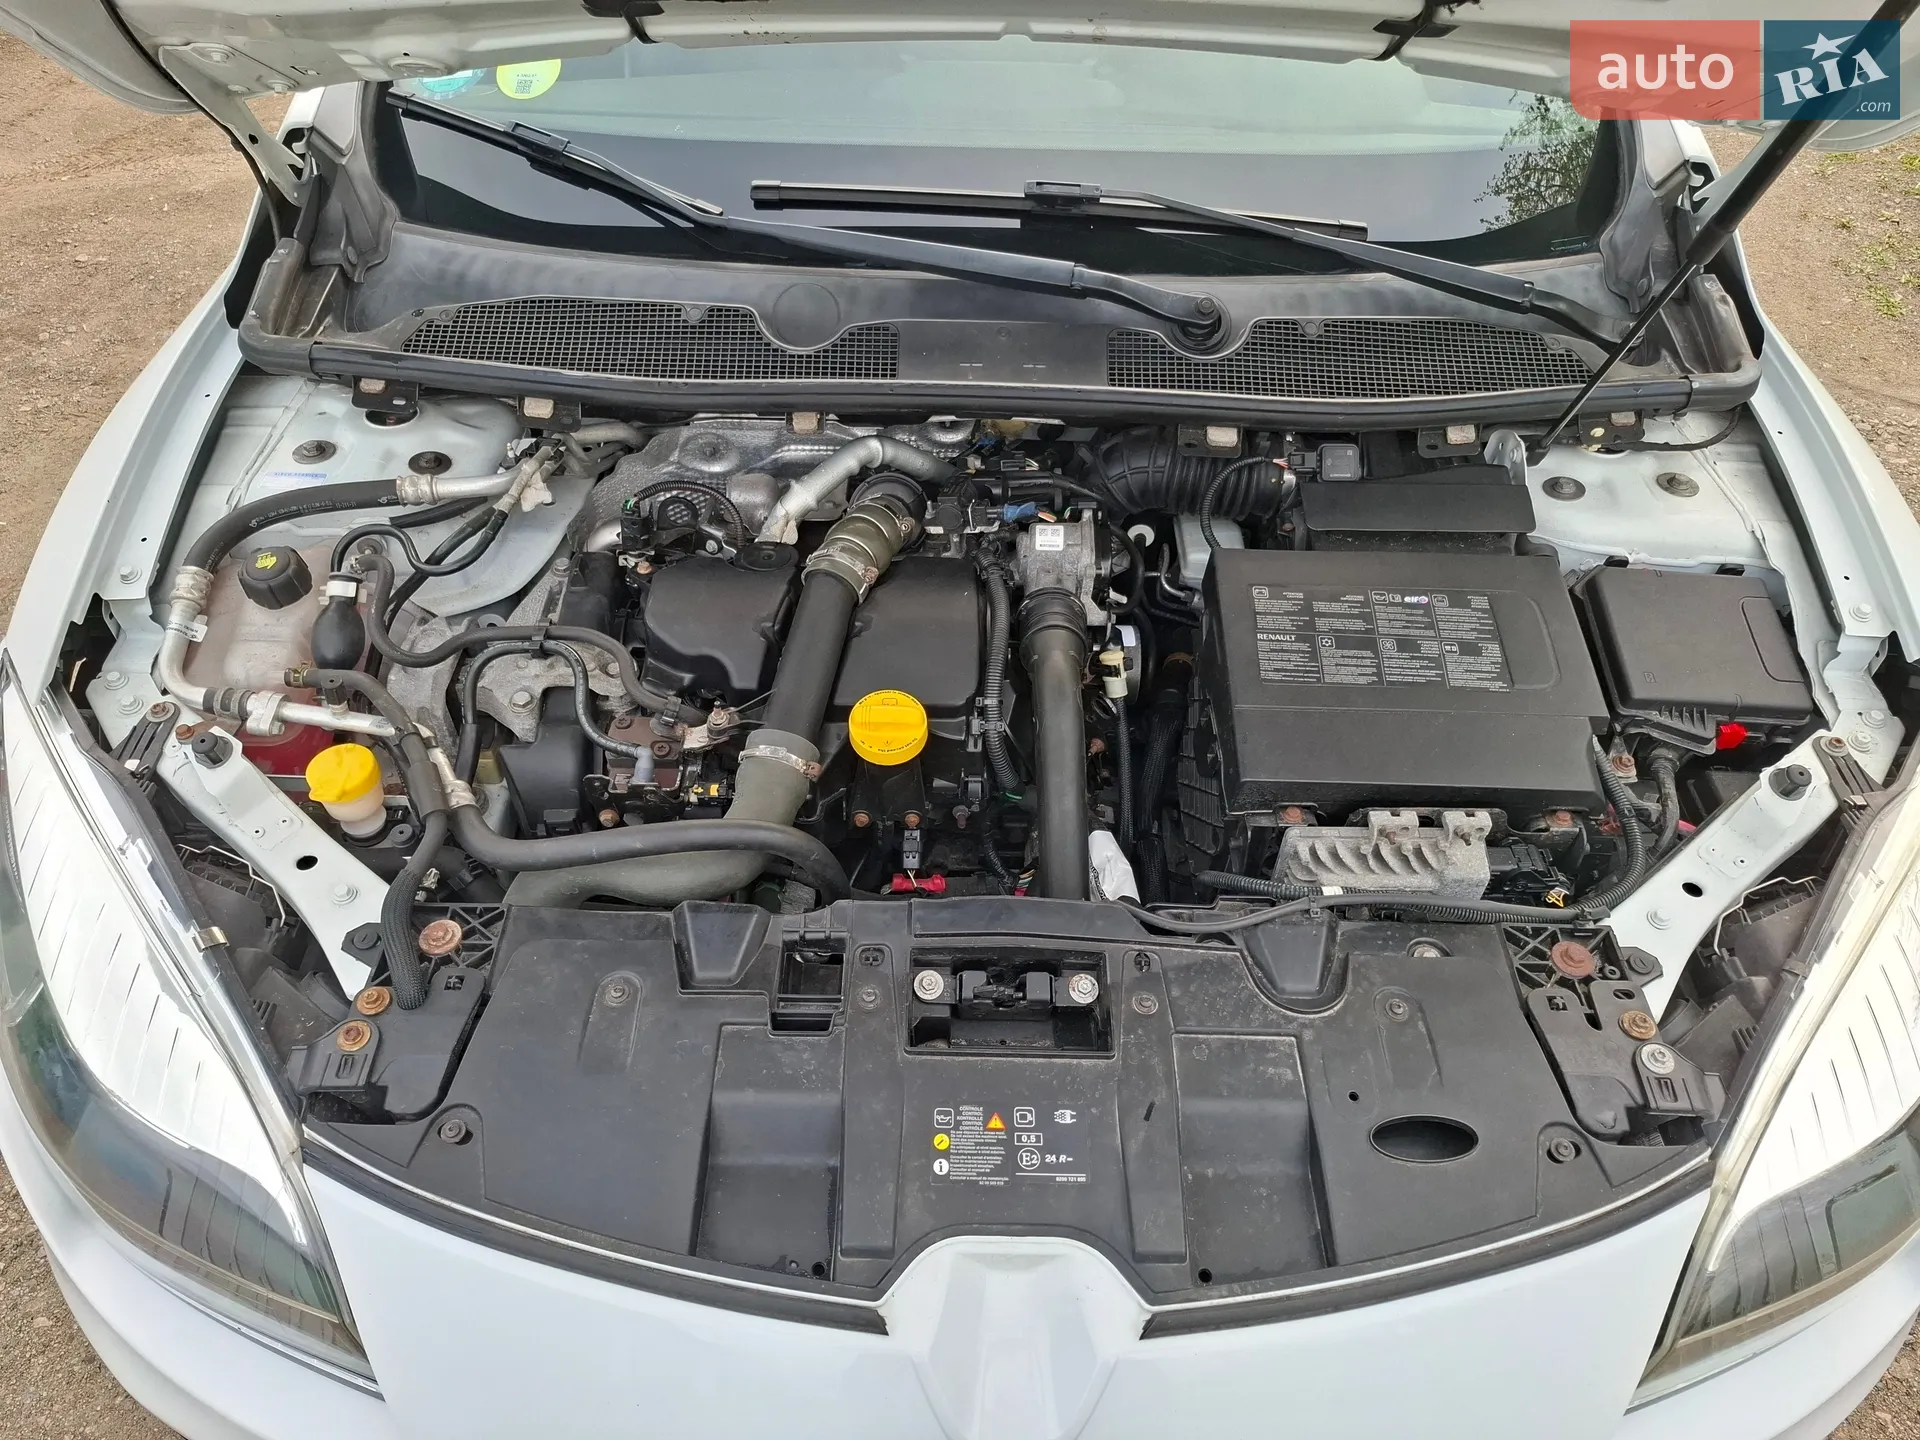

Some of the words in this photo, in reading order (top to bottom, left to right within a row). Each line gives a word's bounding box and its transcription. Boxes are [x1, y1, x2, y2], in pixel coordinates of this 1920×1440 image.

[1022, 1135, 1036, 1143] 0,5
[1022, 1153, 1038, 1165] E2
[1045, 1154, 1056, 1162] 24
